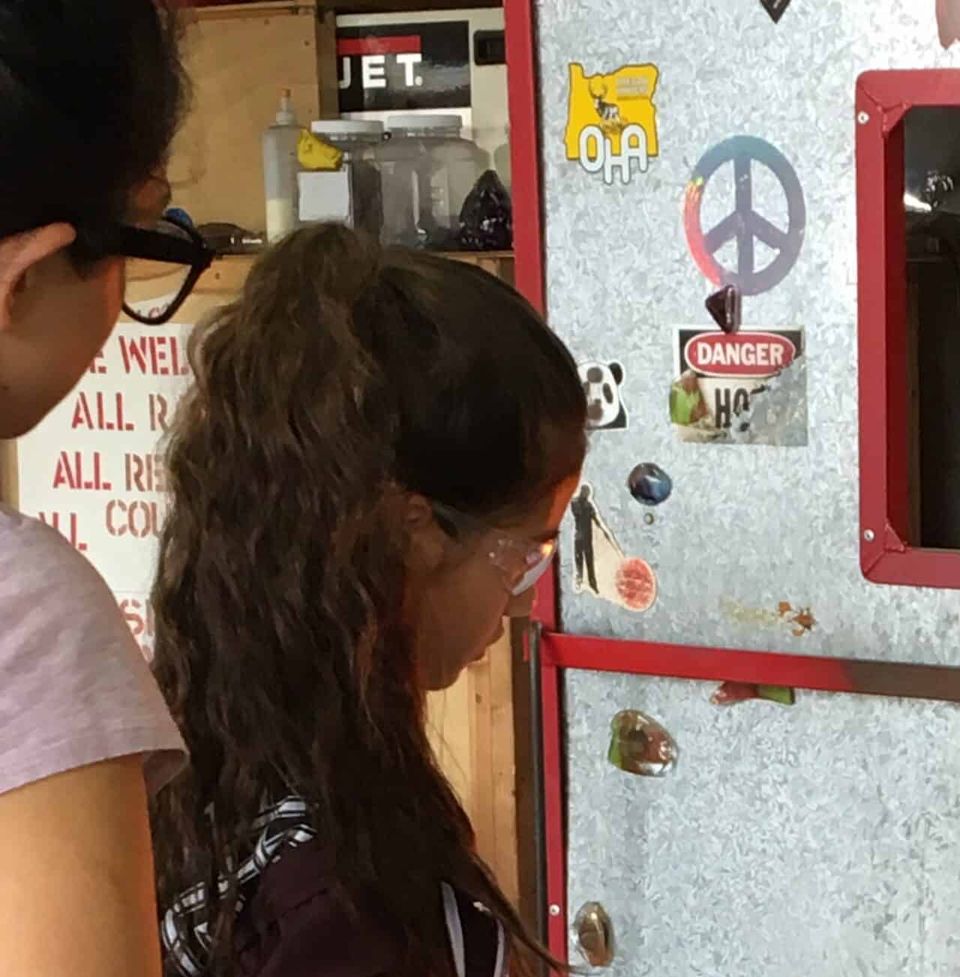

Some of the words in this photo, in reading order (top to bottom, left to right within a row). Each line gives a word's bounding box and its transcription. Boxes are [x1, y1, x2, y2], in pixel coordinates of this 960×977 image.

[579, 124, 648, 185] OHA
[697, 341, 784, 367] DANGER
[72, 391, 134, 431] ALL
[715, 384, 771, 432] HO
[53, 451, 111, 490] ALL
